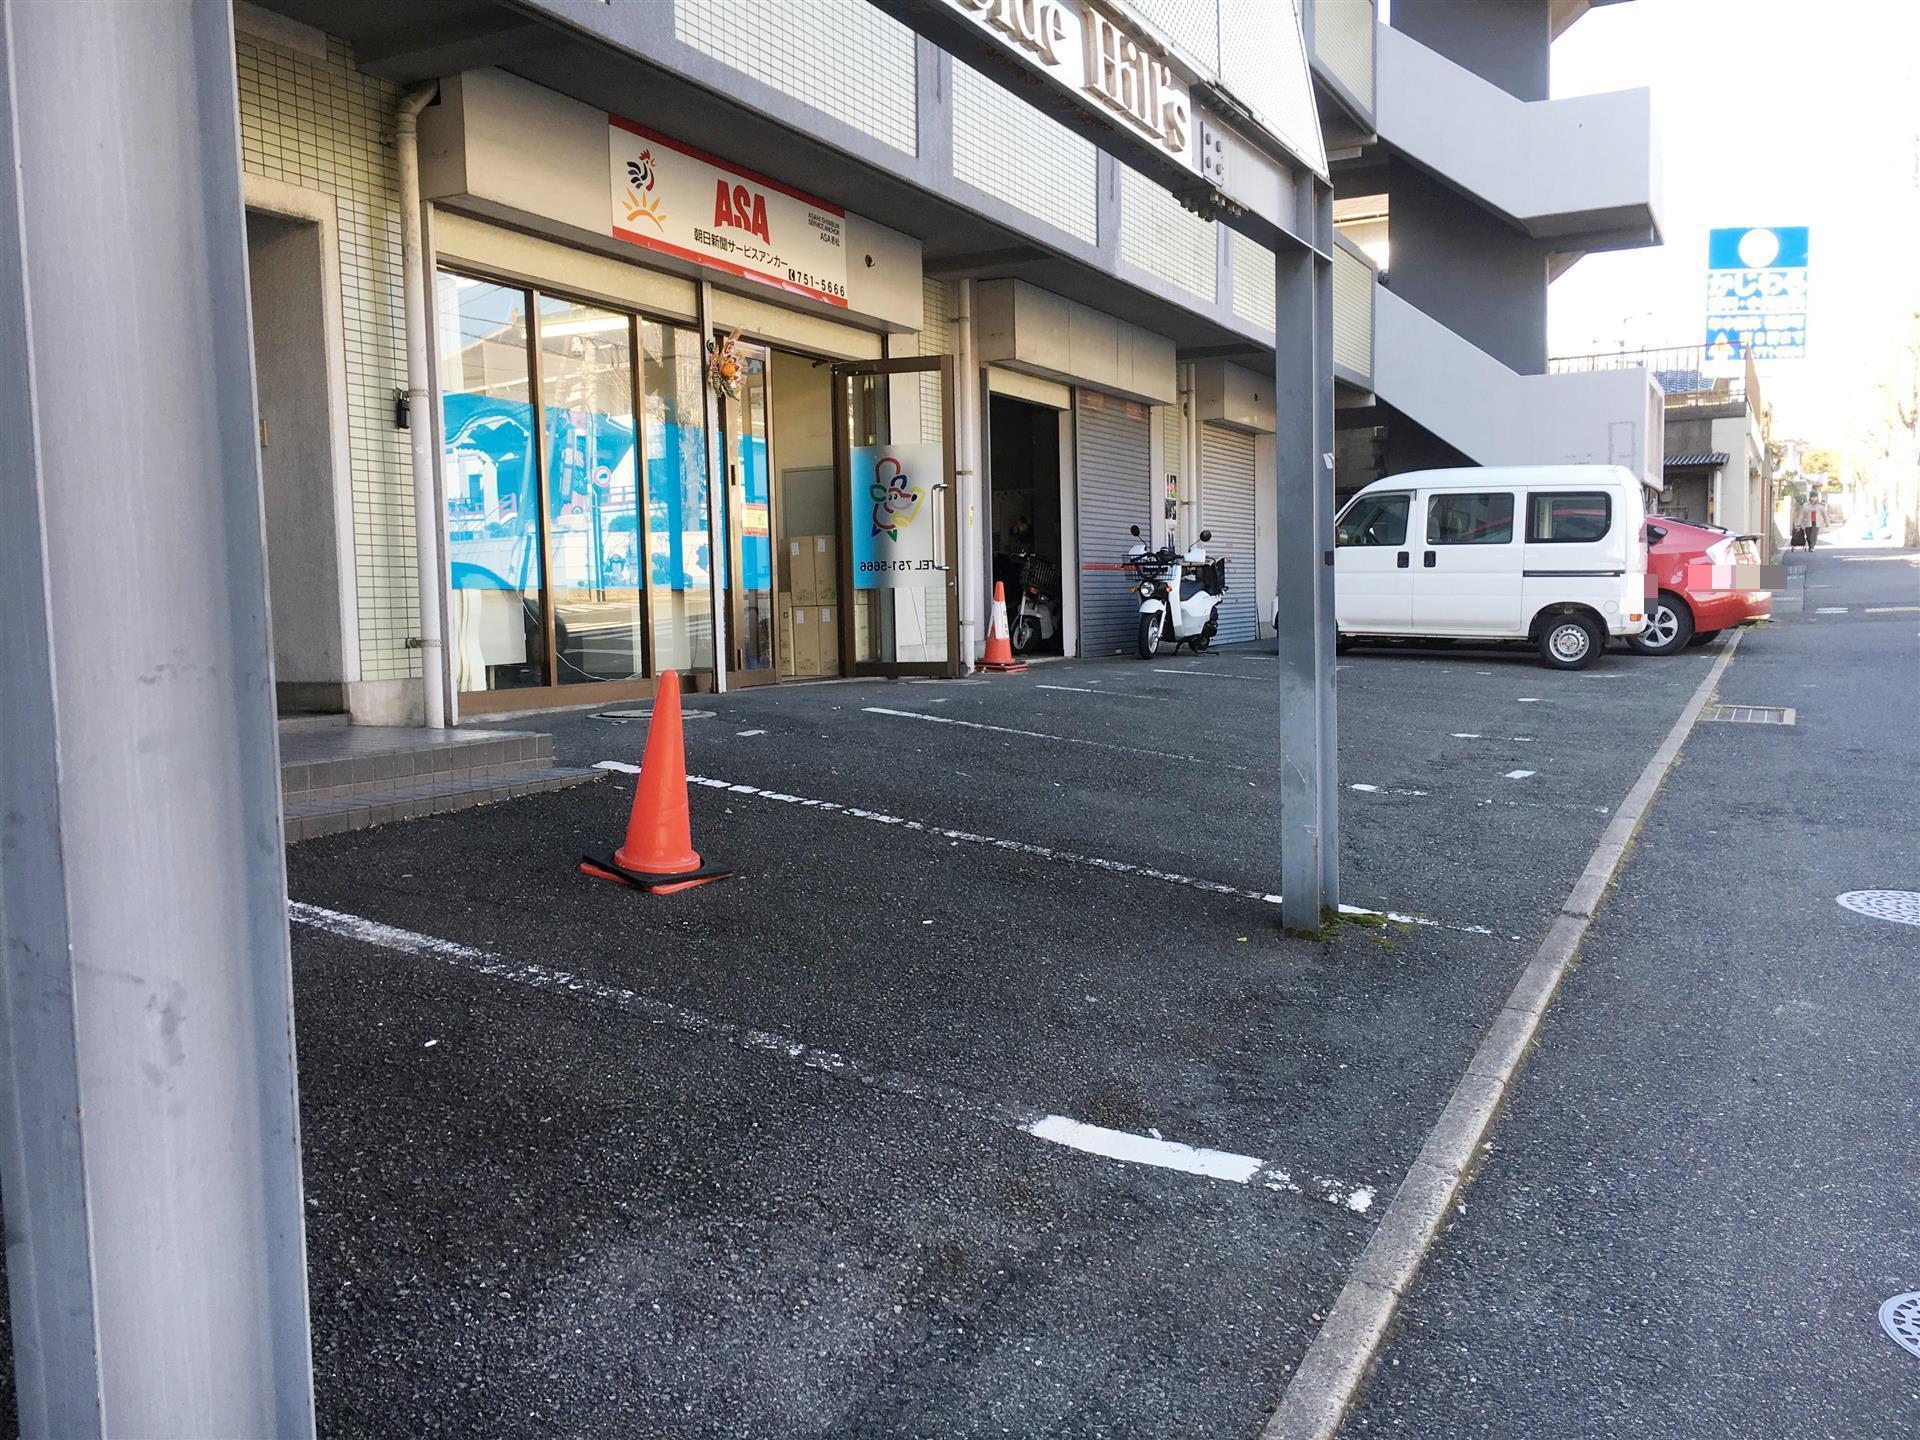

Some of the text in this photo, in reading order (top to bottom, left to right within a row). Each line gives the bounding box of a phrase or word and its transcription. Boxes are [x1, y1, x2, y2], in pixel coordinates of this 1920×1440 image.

[1080, 6, 1187, 153] Hill's
[714, 179, 770, 246] ASA
[694, 228, 788, 268] 朝日新聞サービスアンカー
[796, 270, 845, 297] 751-5666
